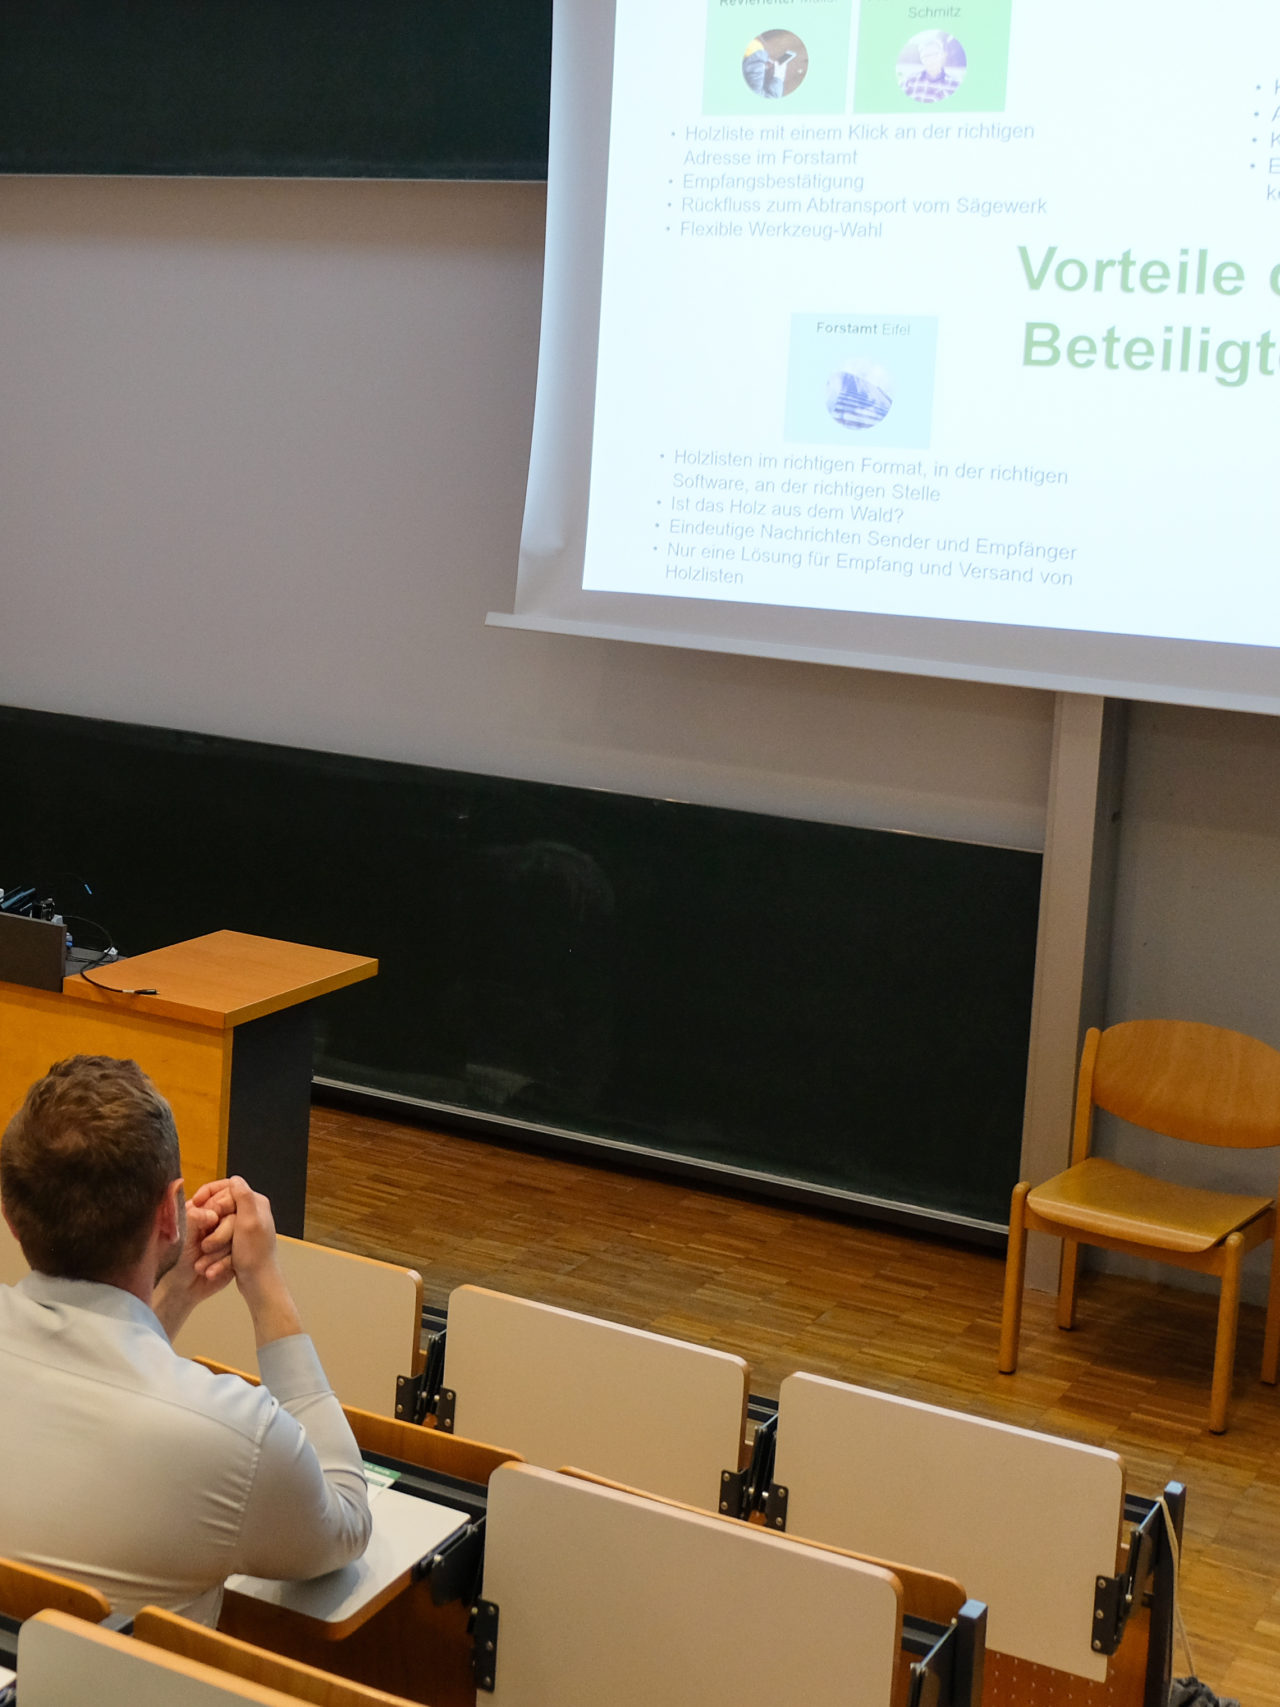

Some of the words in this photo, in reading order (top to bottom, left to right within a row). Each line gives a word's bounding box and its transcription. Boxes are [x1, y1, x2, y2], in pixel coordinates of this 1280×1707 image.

[908, 6, 961, 19] Schmitz
[685, 126, 754, 142] Holzliste
[760, 125, 784, 141] mit
[791, 125, 842, 140] einem
[848, 124, 888, 140] Klick
[895, 127, 916, 140] an
[922, 124, 950, 139] der
[957, 122, 1035, 143] richtigen
[683, 150, 751, 165] Adresse
[757, 150, 776, 165] im
[782, 149, 857, 165] Forstamt
[683, 173, 864, 192] Empfangsbestätigung
[682, 197, 760, 213] Rückfluss
[766, 200, 801, 213] zum
[806, 197, 906, 216] Abtransport
[913, 201, 949, 214] vom
[956, 196, 1048, 217] Sägewerk
[680, 221, 742, 237] Flexible
[749, 221, 883, 240] Werkzeug-Wahl
[1017, 245, 1245, 296] Vorteile
[816, 321, 878, 335] Forstamt
[882, 322, 911, 337] Eifel
[1022, 321, 1280, 388] Beteiligt
[674, 449, 752, 468] Holzlisten
[759, 453, 777, 469] im
[783, 454, 854, 474] richtigen
[861, 457, 927, 479] Format,
[933, 461, 948, 478] in
[955, 462, 984, 480] der
[990, 465, 1068, 486] richtigen
[672, 472, 749, 494] Software,
[754, 480, 775, 493] an
[781, 478, 808, 494] der
[813, 480, 885, 500] richtigen
[892, 483, 941, 502] Stelle
[671, 496, 689, 512] Ist
[695, 497, 724, 513] das
[729, 499, 766, 516] Holz
[772, 504, 801, 518] aus
[807, 503, 844, 520] dem
[850, 505, 904, 524] Wald?
[669, 518, 754, 540] Eindeutige
[760, 524, 861, 545] Nachrichten
[867, 530, 931, 550] Sender
[936, 537, 969, 553] und
[976, 538, 1078, 563] Empfänger
[665, 564, 743, 585] Holzlisten
[667, 542, 696, 558] Nur
[701, 544, 735, 560] eine
[741, 546, 802, 568] Lösung
[808, 550, 830, 567] für
[836, 552, 913, 577] Empfang
[919, 561, 952, 577] und
[959, 561, 1033, 583] Versand
[1040, 571, 1073, 586] von
